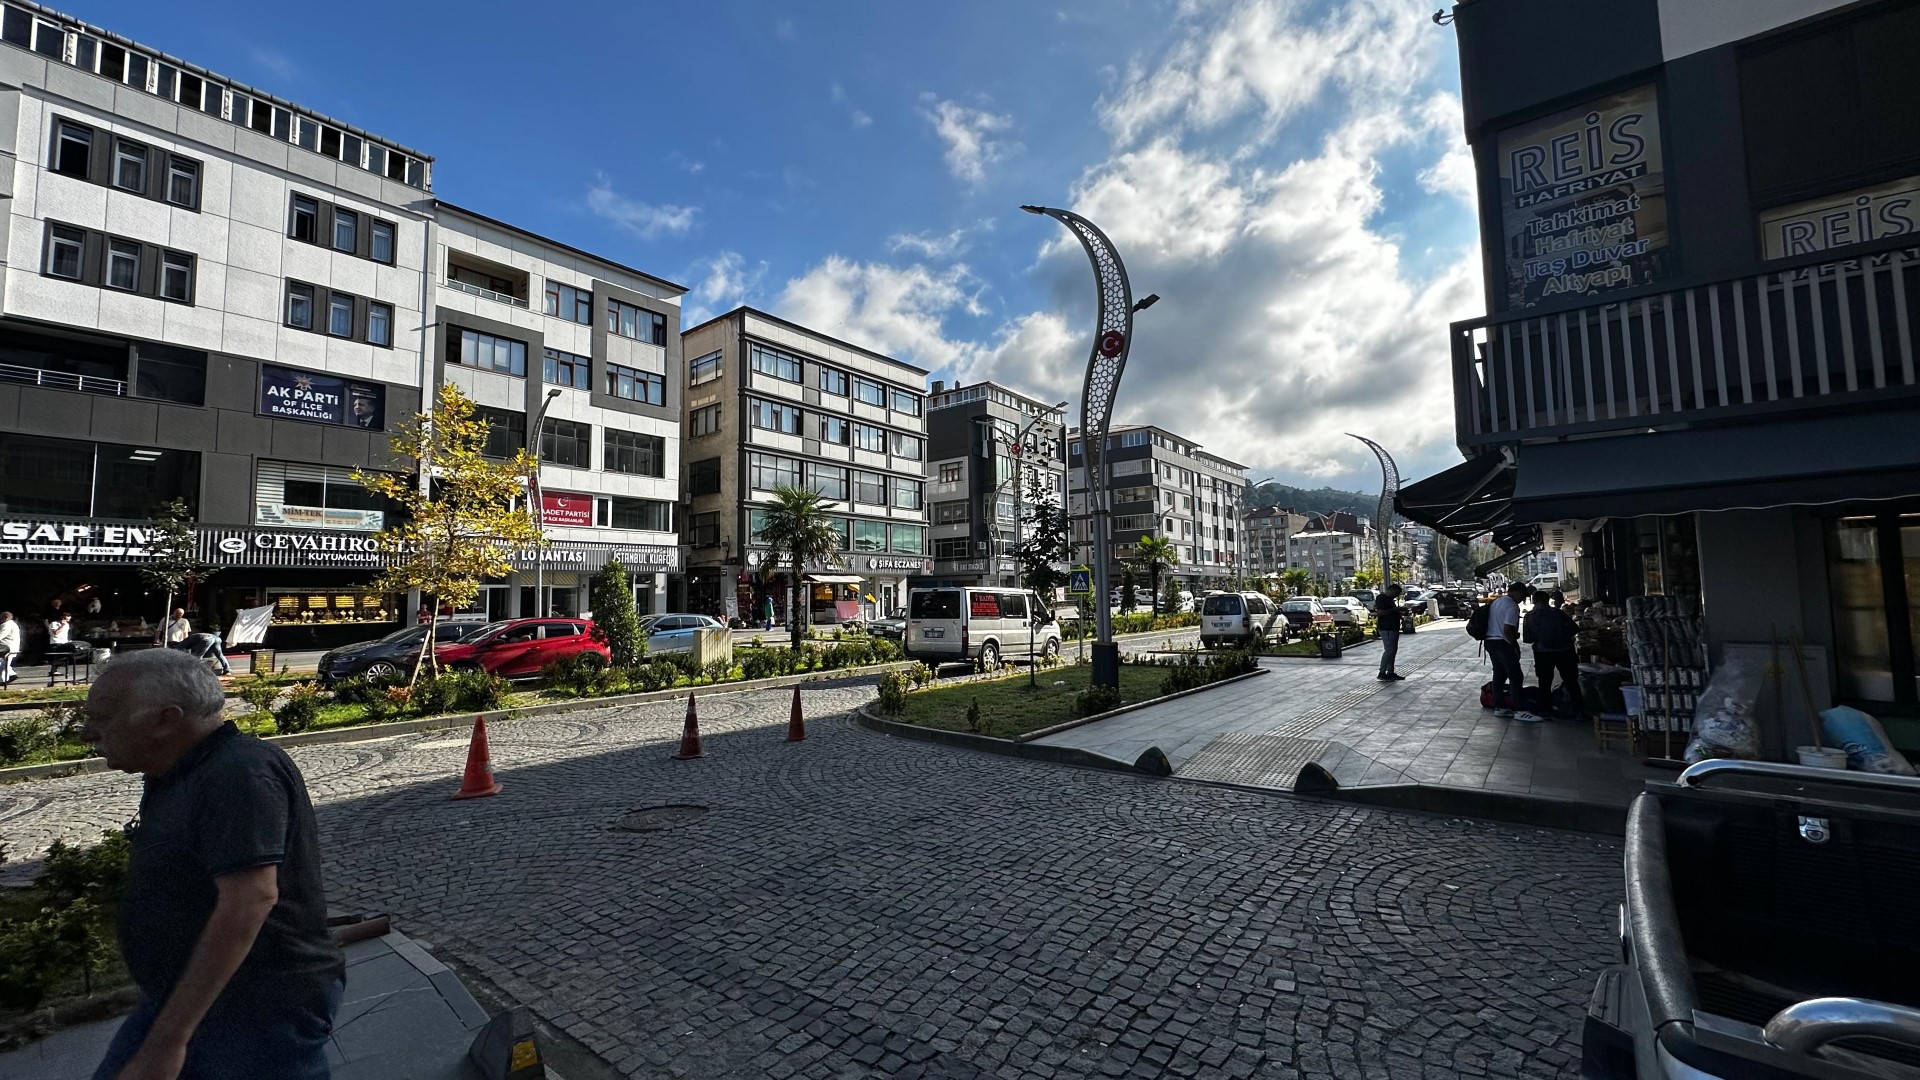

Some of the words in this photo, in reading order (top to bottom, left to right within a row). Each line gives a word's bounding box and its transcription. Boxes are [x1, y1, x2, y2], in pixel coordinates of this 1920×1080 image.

[1510, 111, 1645, 194] REİS
[1518, 164, 1643, 208] HAFRİYAT
[1526, 193, 1641, 237] Tahkimat
[1534, 216, 1634, 256] Hafriyat
[1523, 258, 1567, 278] Taş
[1571, 238, 1650, 269] Duvar
[1541, 264, 1632, 297] Altyapı
[267, 385, 291, 398] AK
[294, 389, 339, 406] PARTİ
[271, 405, 333, 420] BAŞKANLIĞI
[283, 399, 297, 407] OF
[301, 401, 323, 411] İLÇE
[308, 552, 380, 562] KUYUMCULUK
